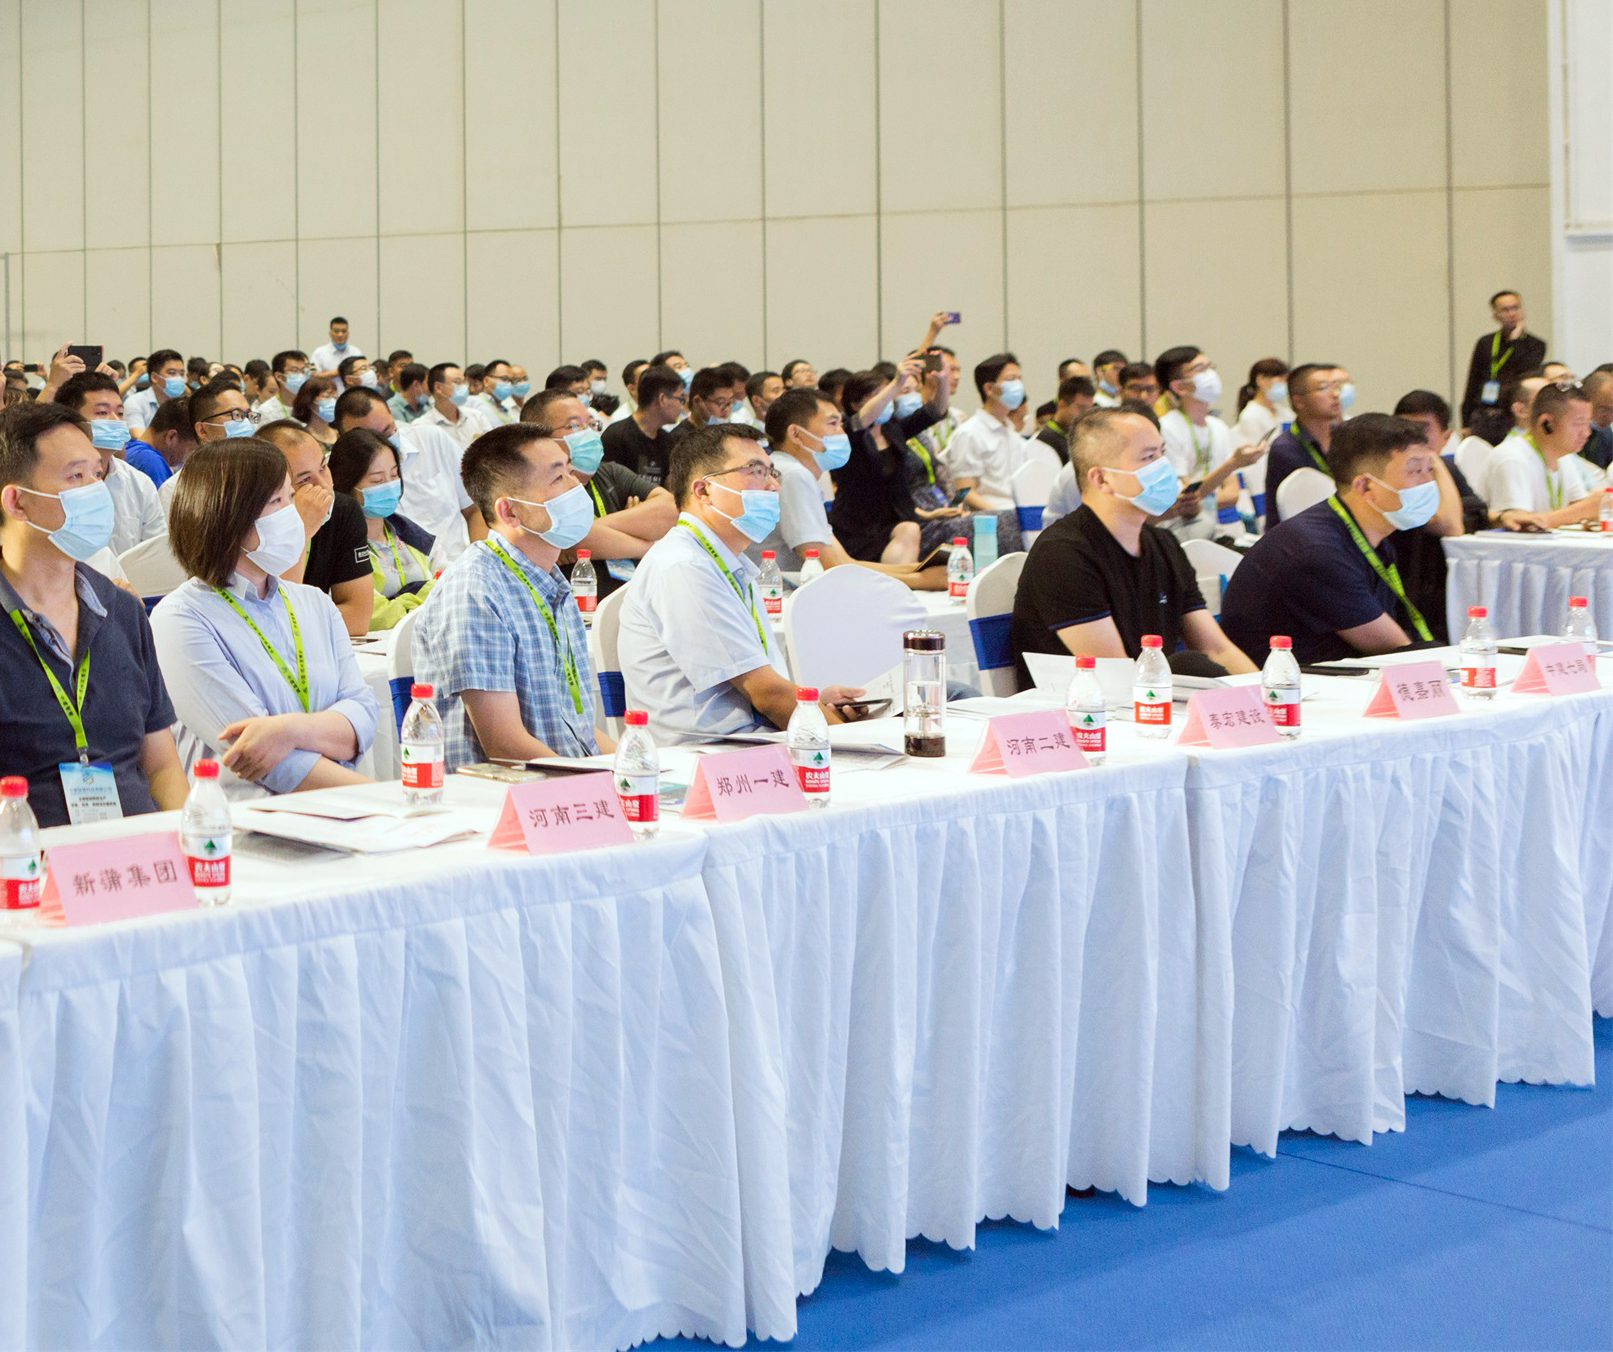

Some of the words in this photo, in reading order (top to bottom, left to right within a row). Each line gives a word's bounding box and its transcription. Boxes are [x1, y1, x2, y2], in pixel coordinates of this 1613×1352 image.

[1006, 732, 1071, 756] 河南二建
[716, 769, 789, 797] 郑州一建
[529, 799, 615, 828] 河南三建
